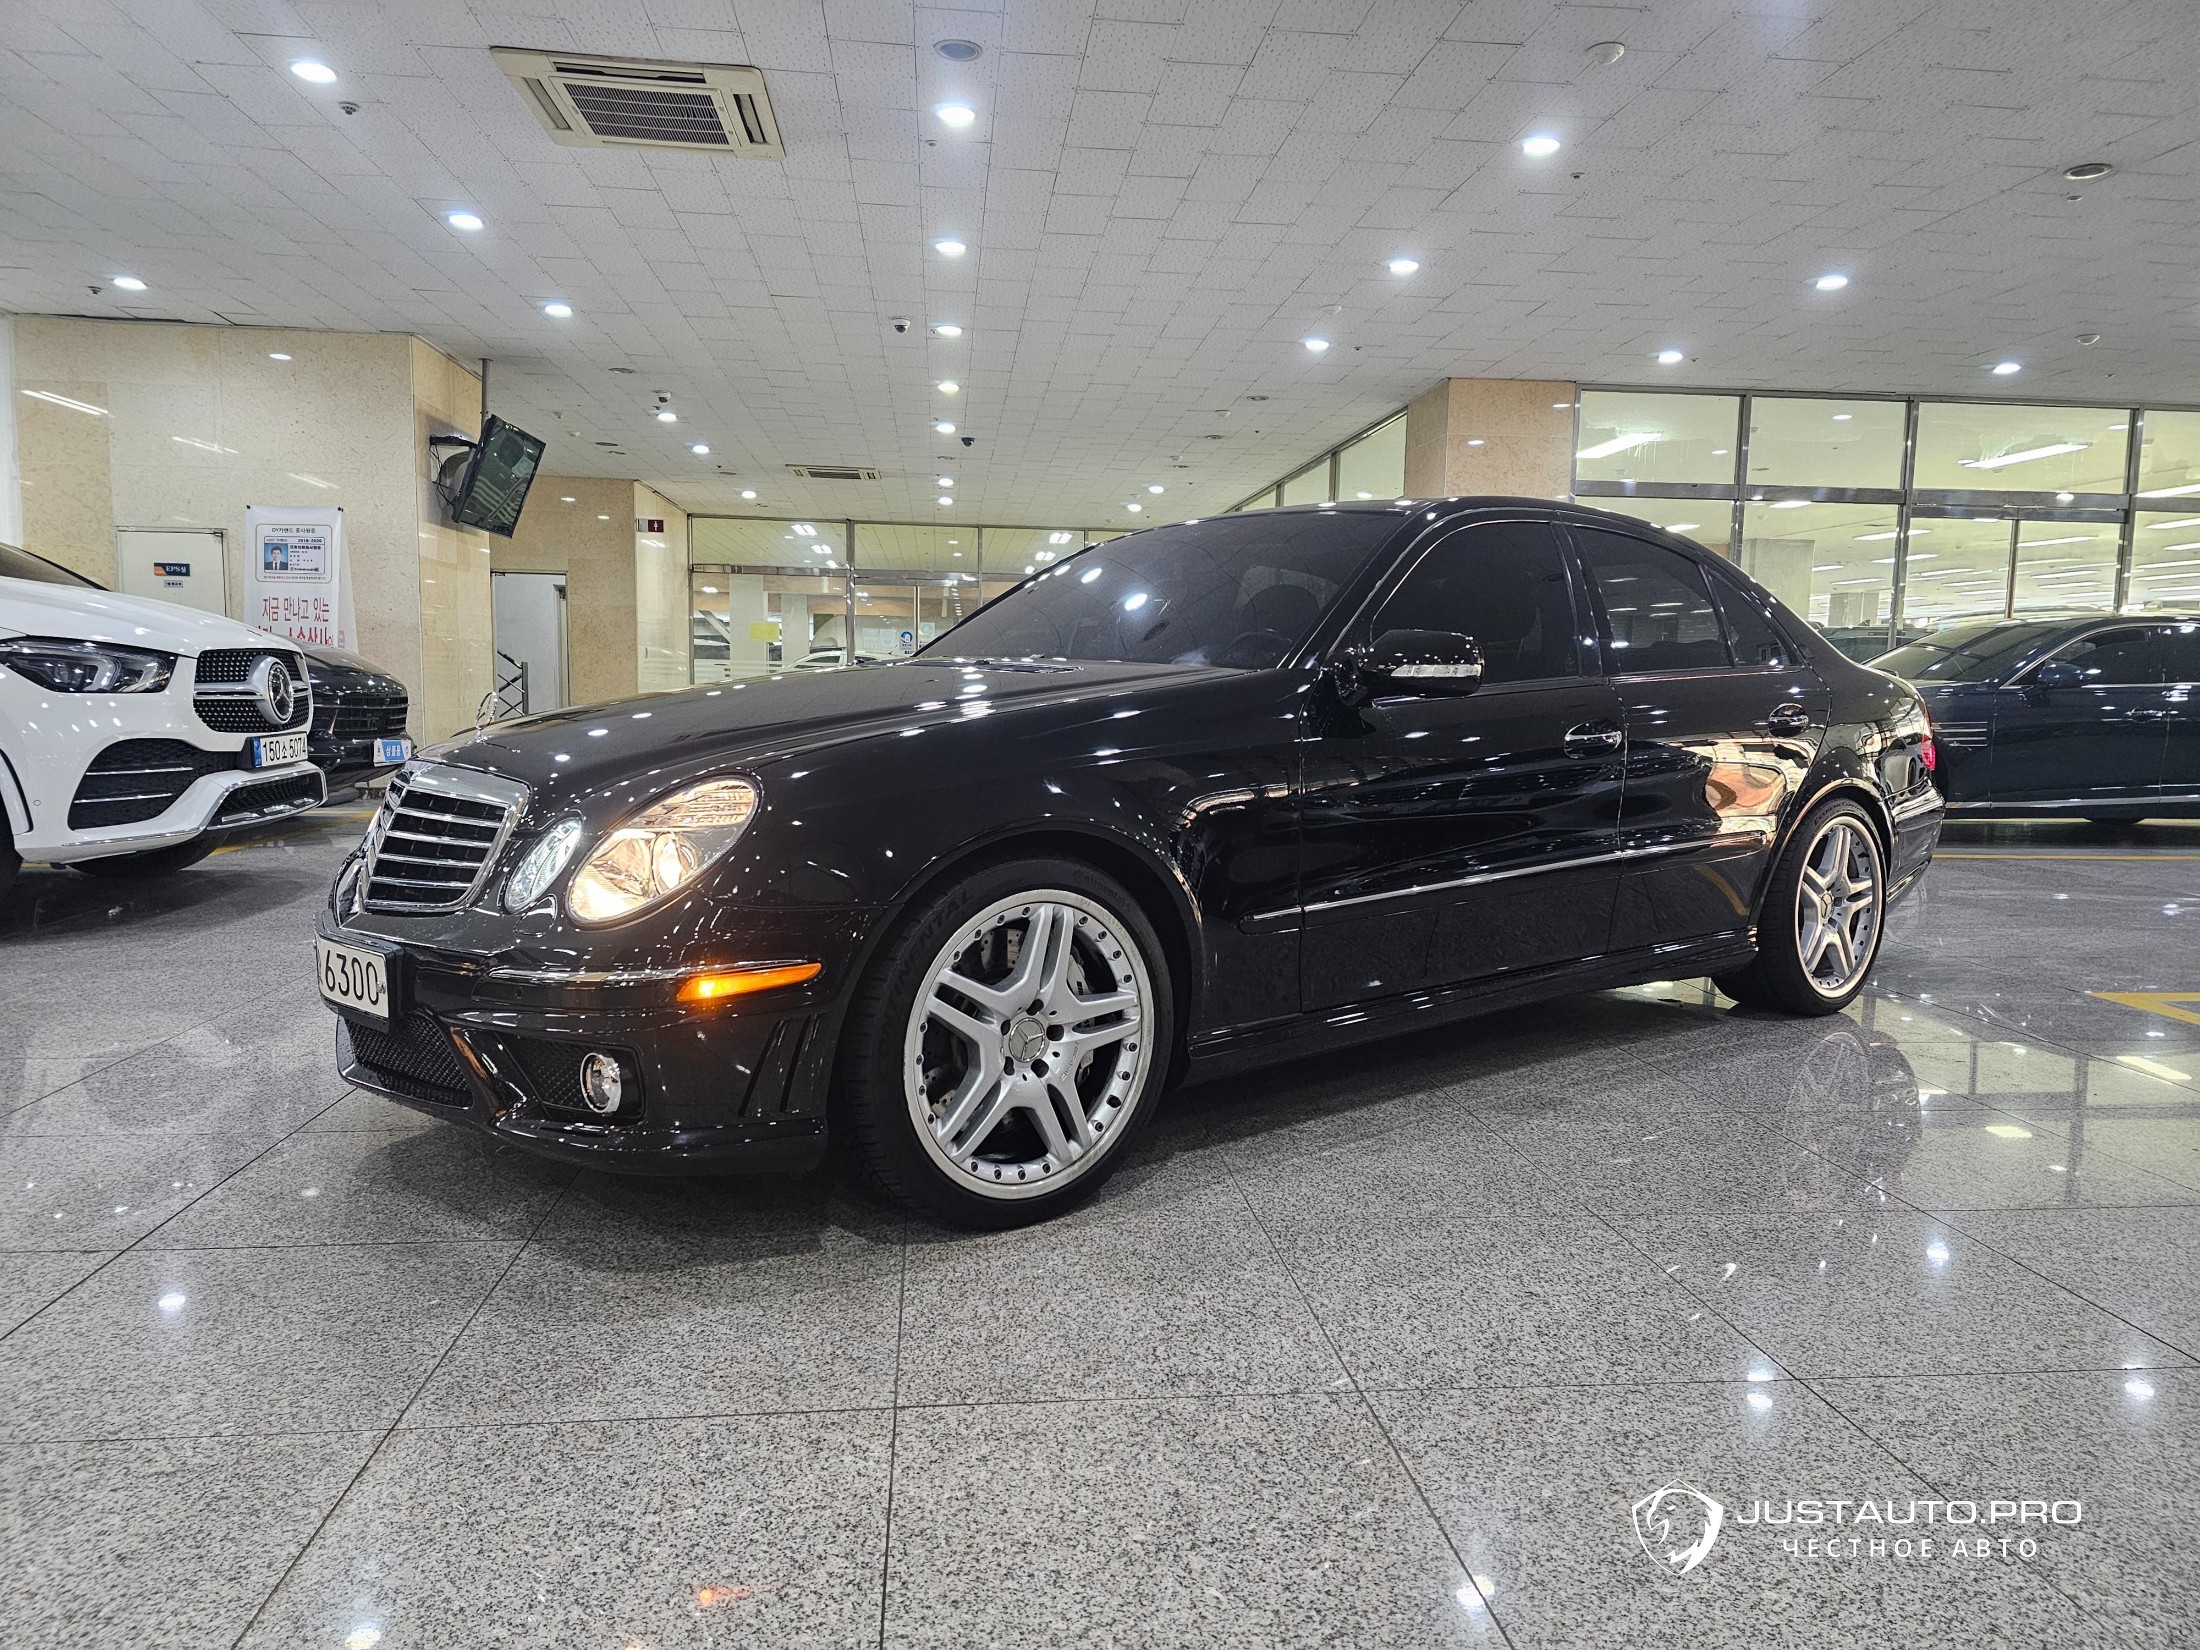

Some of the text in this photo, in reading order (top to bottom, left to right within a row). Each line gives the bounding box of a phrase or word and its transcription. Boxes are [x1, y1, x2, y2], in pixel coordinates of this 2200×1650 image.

[165, 565, 187, 574] EPS실
[262, 596, 330, 622] 지금 만나고 있는
[262, 737, 306, 762] 150소 5074
[385, 744, 401, 757] 상품용
[325, 949, 379, 1005] 6300
